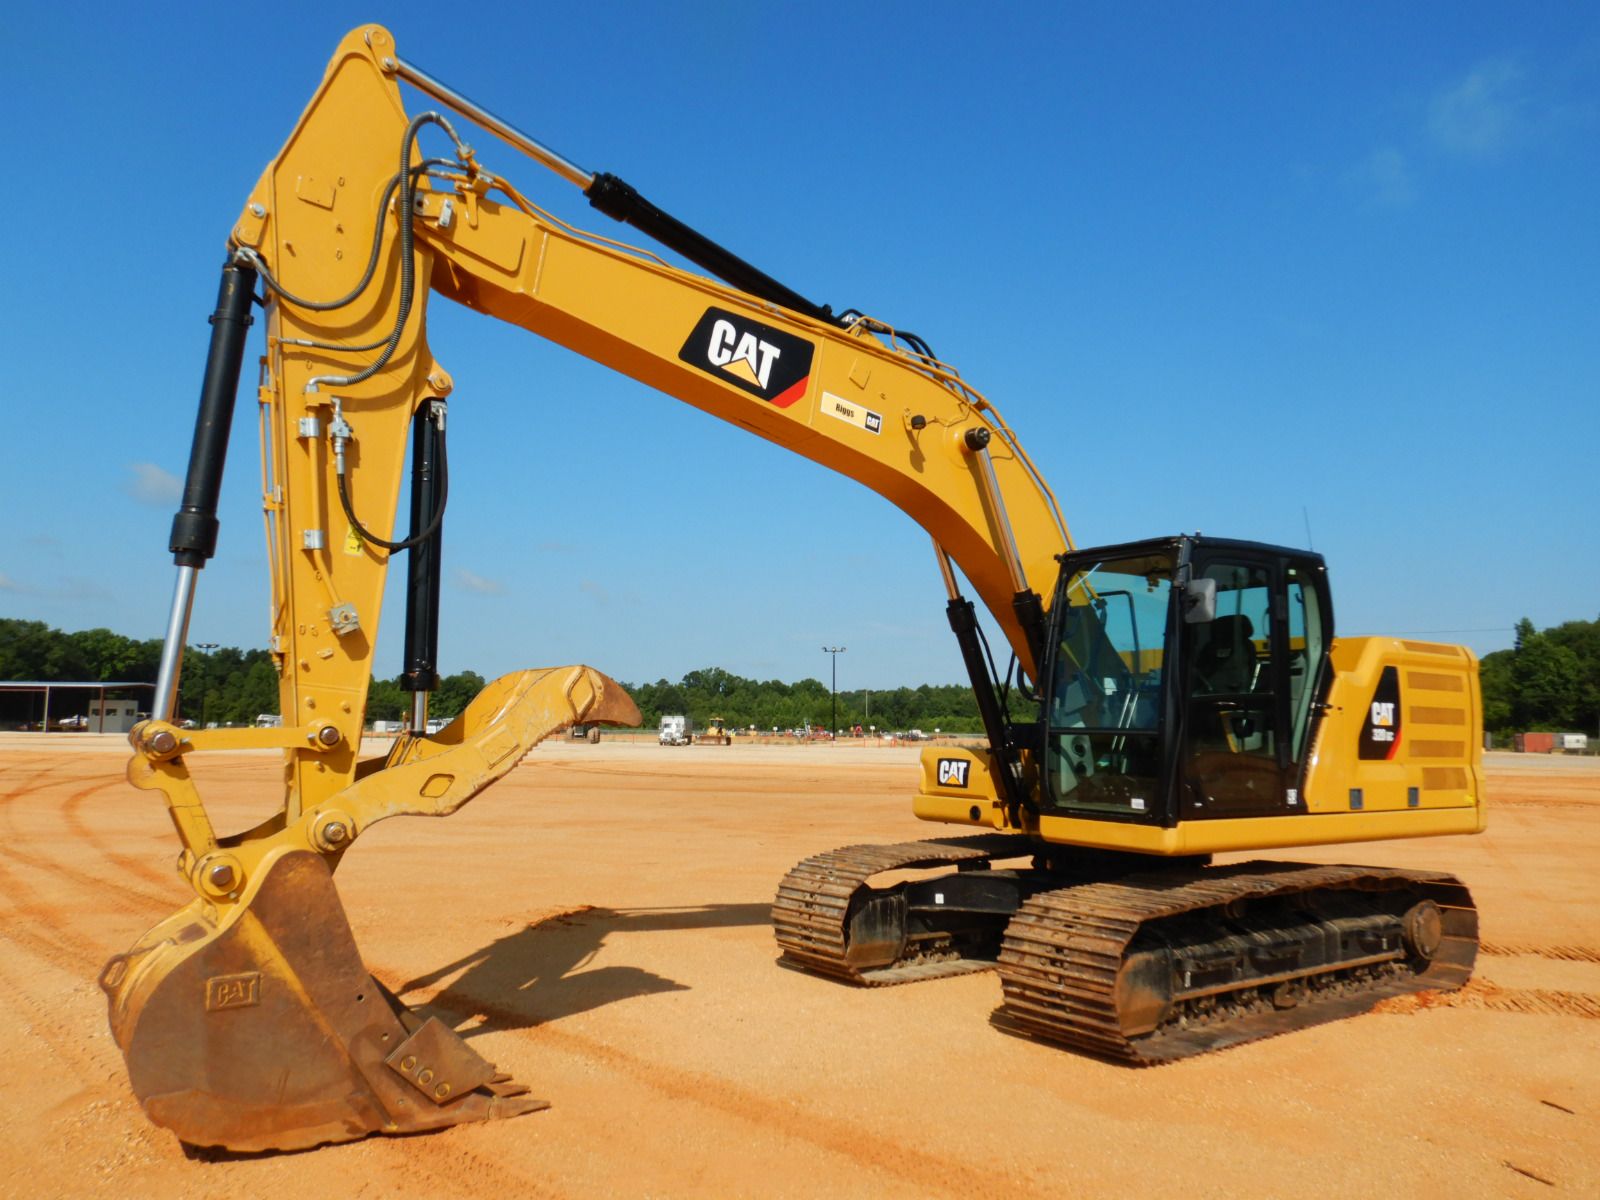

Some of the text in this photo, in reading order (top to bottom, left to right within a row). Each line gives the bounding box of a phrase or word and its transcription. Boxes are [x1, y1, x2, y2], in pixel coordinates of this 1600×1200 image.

[707, 319, 781, 390] CAT
[836, 403, 880, 429] Riggs CAT
[1371, 701, 1395, 726] CAT
[939, 760, 967, 785] CAT
[217, 979, 256, 1007] CAT
